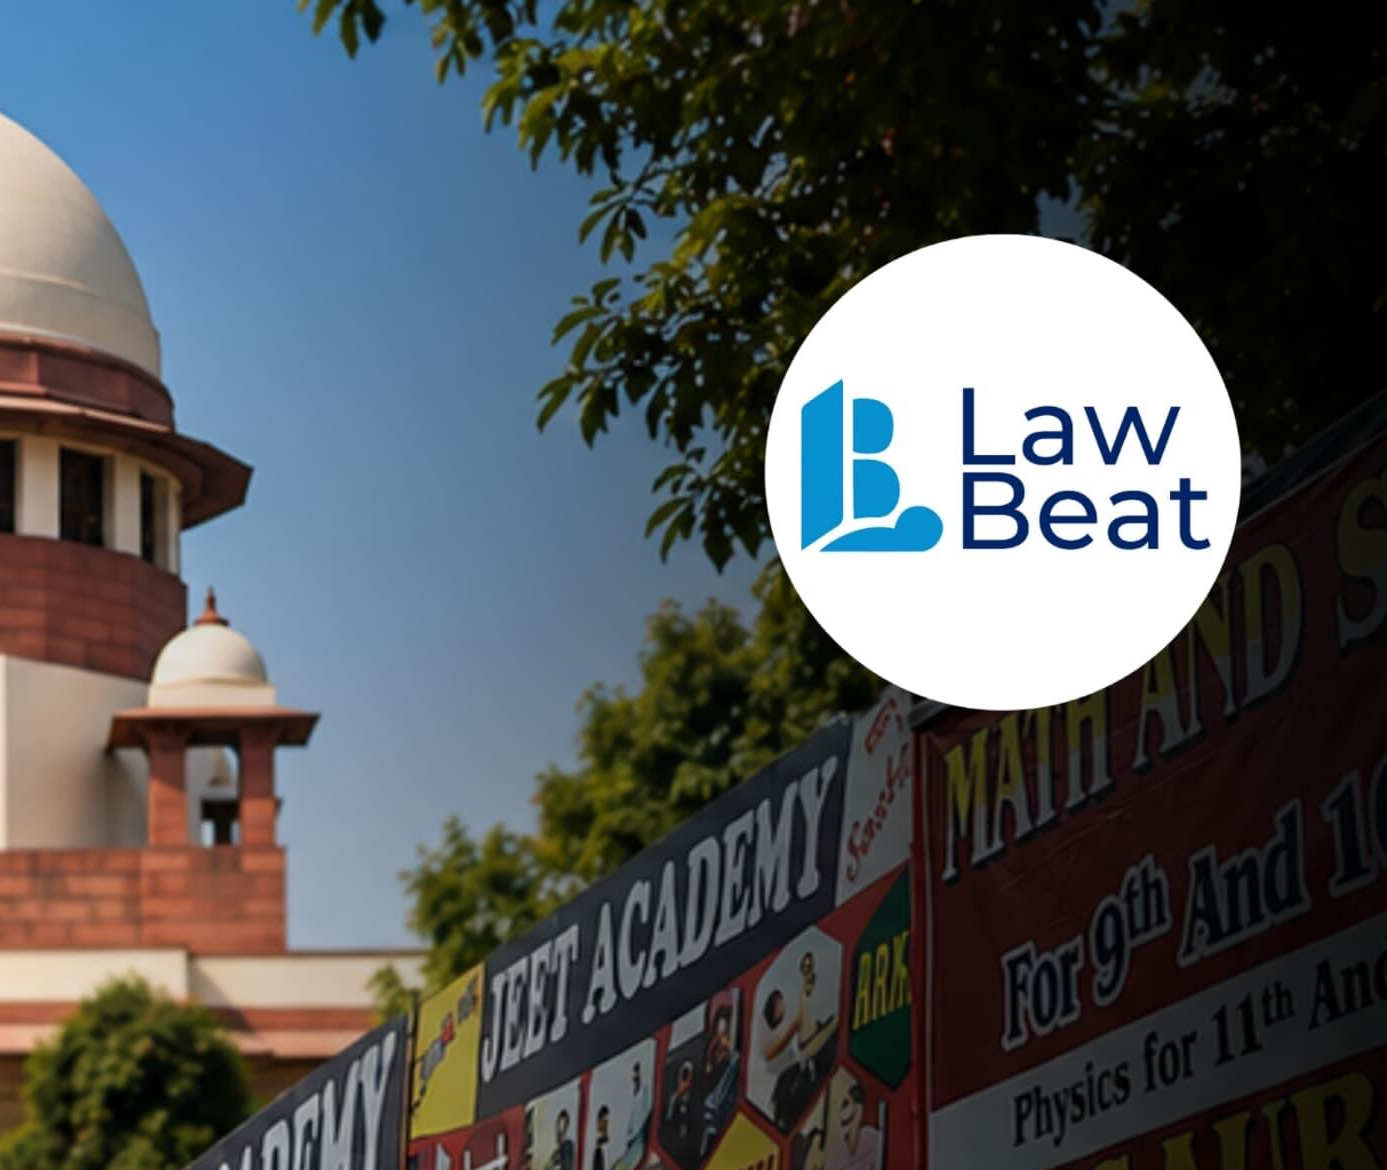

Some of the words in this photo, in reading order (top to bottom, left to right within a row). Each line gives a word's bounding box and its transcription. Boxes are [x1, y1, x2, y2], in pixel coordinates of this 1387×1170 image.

[481, 924, 579, 1083] JEET
[581, 755, 839, 1025] ACADEMY
[1001, 935, 1084, 1052] For
[1089, 853, 1172, 1005] 9th
[1177, 796, 1313, 968] And
[1013, 1062, 1130, 1147] Physics
[1144, 1032, 1198, 1094] for
[1212, 981, 1295, 1067] 11th
